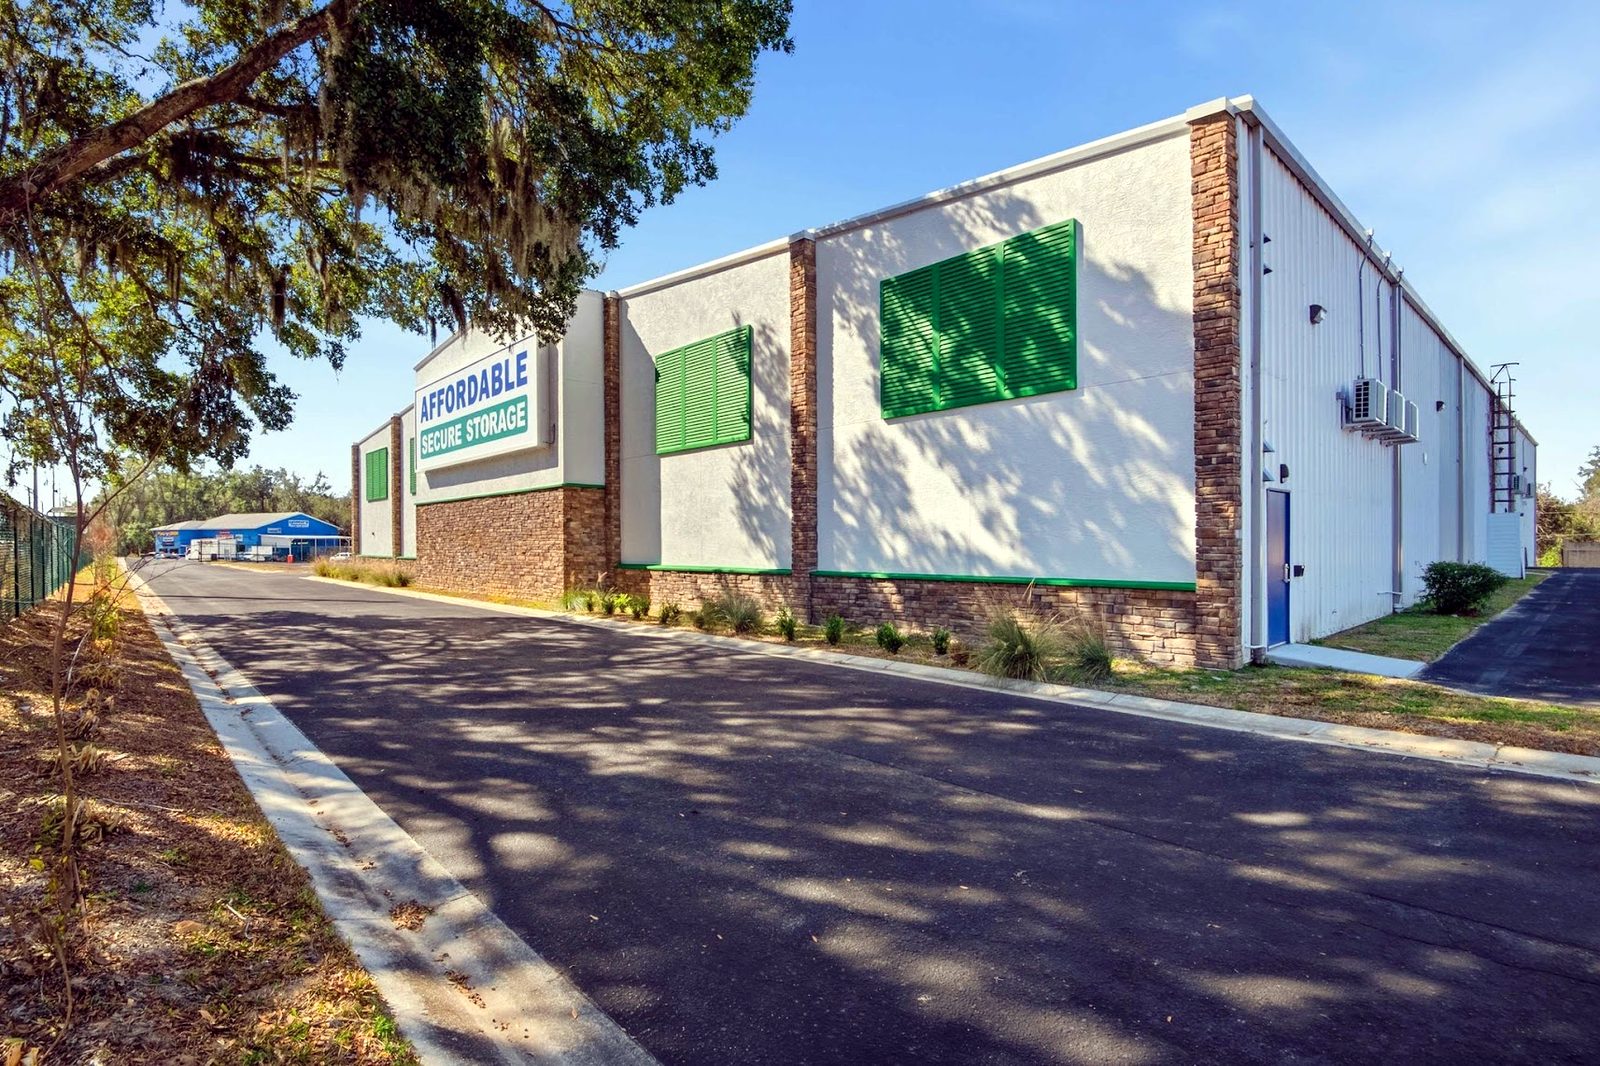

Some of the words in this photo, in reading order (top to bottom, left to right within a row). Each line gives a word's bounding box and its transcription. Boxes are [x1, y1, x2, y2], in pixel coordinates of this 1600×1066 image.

[420, 350, 528, 424] AFFORDABLE
[422, 423, 462, 455] SECURE
[466, 402, 526, 442] STORAGE
